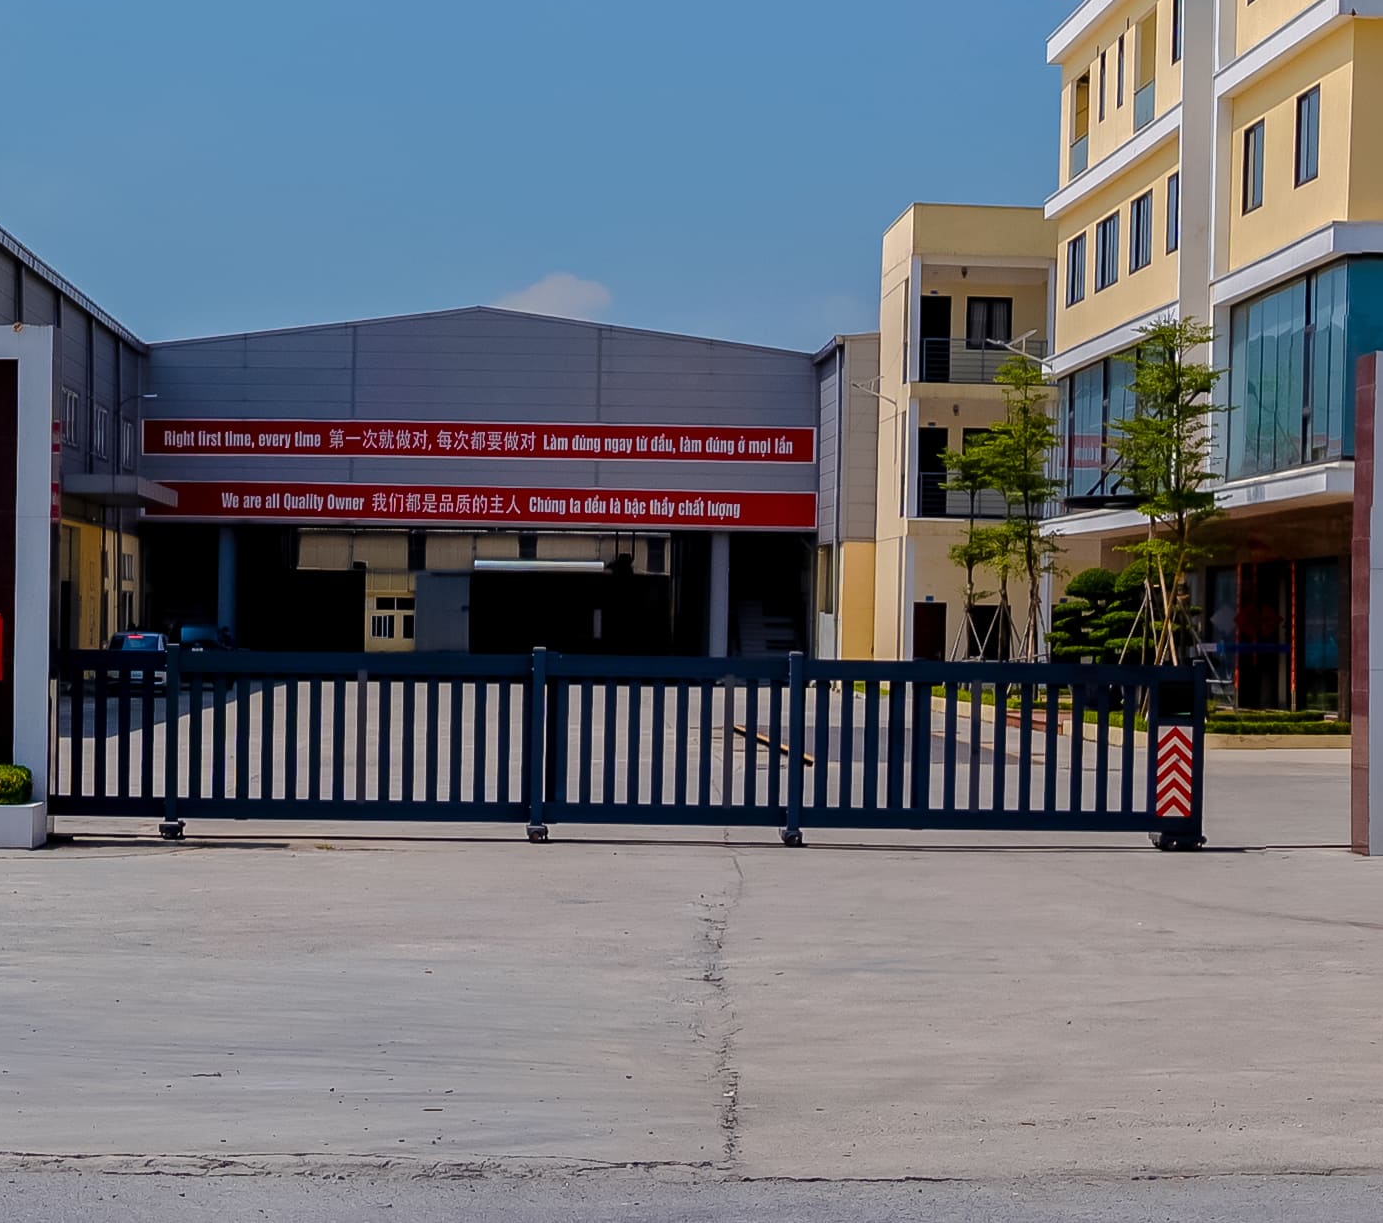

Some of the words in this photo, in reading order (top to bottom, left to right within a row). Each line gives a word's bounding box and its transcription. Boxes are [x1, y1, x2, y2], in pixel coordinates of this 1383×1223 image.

[164, 430, 195, 448] Right
[198, 430, 221, 447] first
[225, 431, 255, 449] time,
[258, 434, 291, 449] every
[295, 432, 321, 448] time
[543, 434, 568, 451] Làm
[572, 434, 601, 453] đúng
[604, 437, 632, 454] ngay
[679, 436, 702, 453] làm
[705, 436, 734, 455] đúng
[221, 491, 240, 508] We
[243, 495, 262, 509] are
[265, 492, 280, 509] all
[283, 493, 324, 511] Quality
[327, 494, 365, 511] Owner
[372, 493, 521, 515] 我们都是品质的主人
[529, 495, 566, 515] Chúng
[569, 498, 581, 514] ta
[610, 497, 621, 515] là
